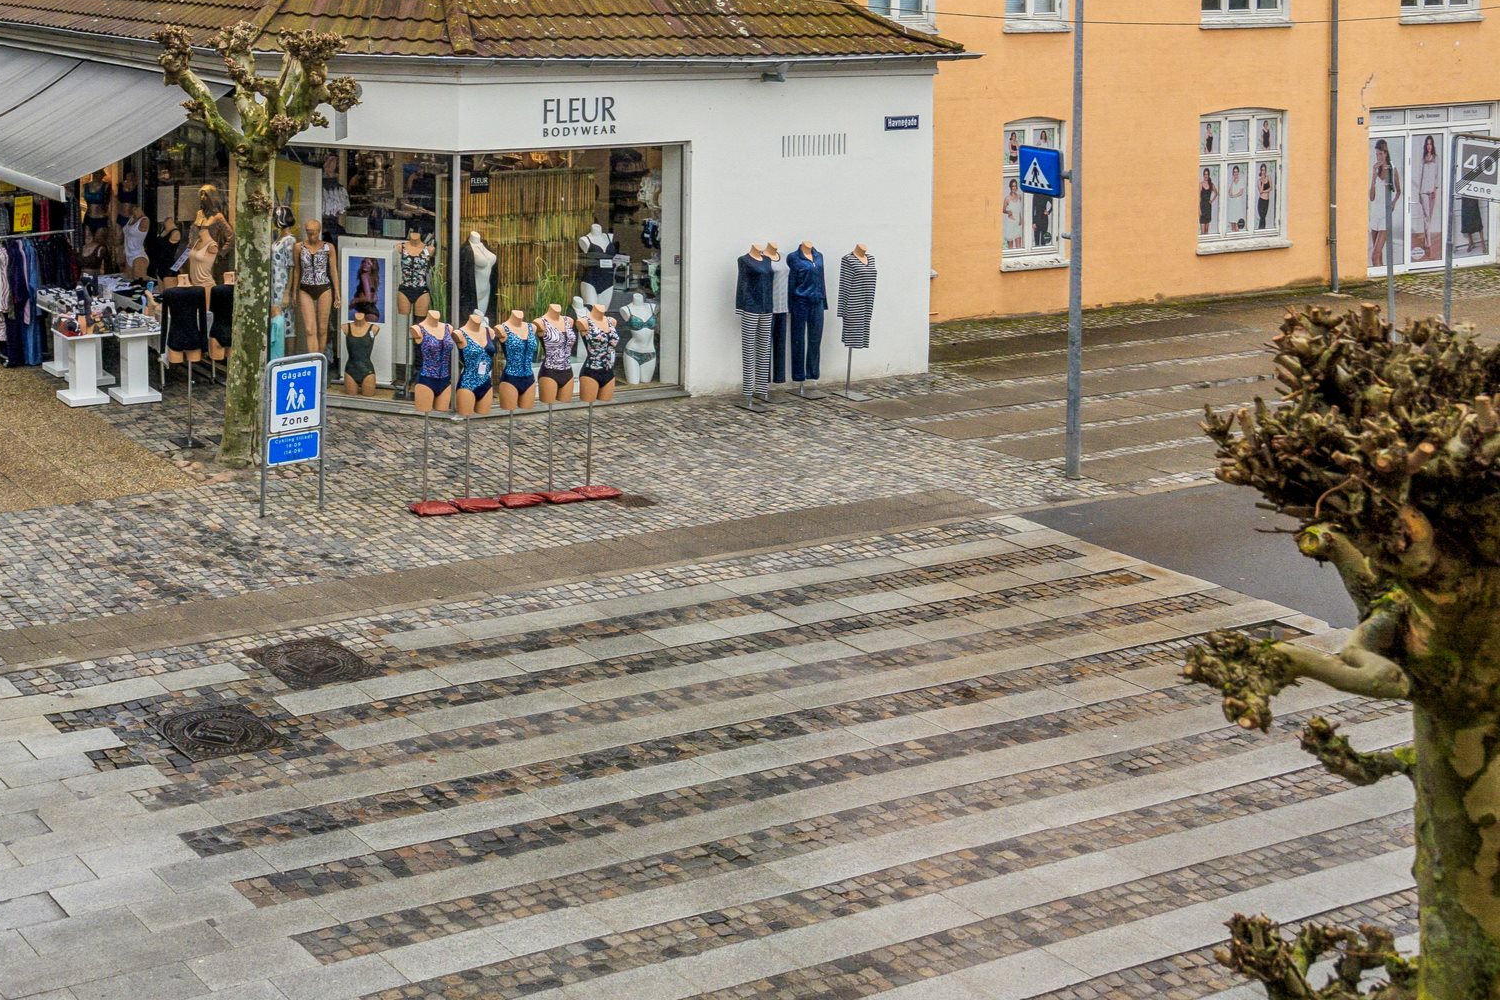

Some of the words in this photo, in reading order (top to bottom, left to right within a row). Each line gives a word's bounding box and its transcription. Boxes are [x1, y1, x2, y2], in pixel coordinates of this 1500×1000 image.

[543, 96, 616, 124] FLEUR
[543, 125, 617, 138] BODYWEAR
[1463, 153, 1496, 176] 40
[1466, 183, 1492, 194] Zone
[281, 370, 311, 380] Gågade
[282, 415, 309, 426] Zone
